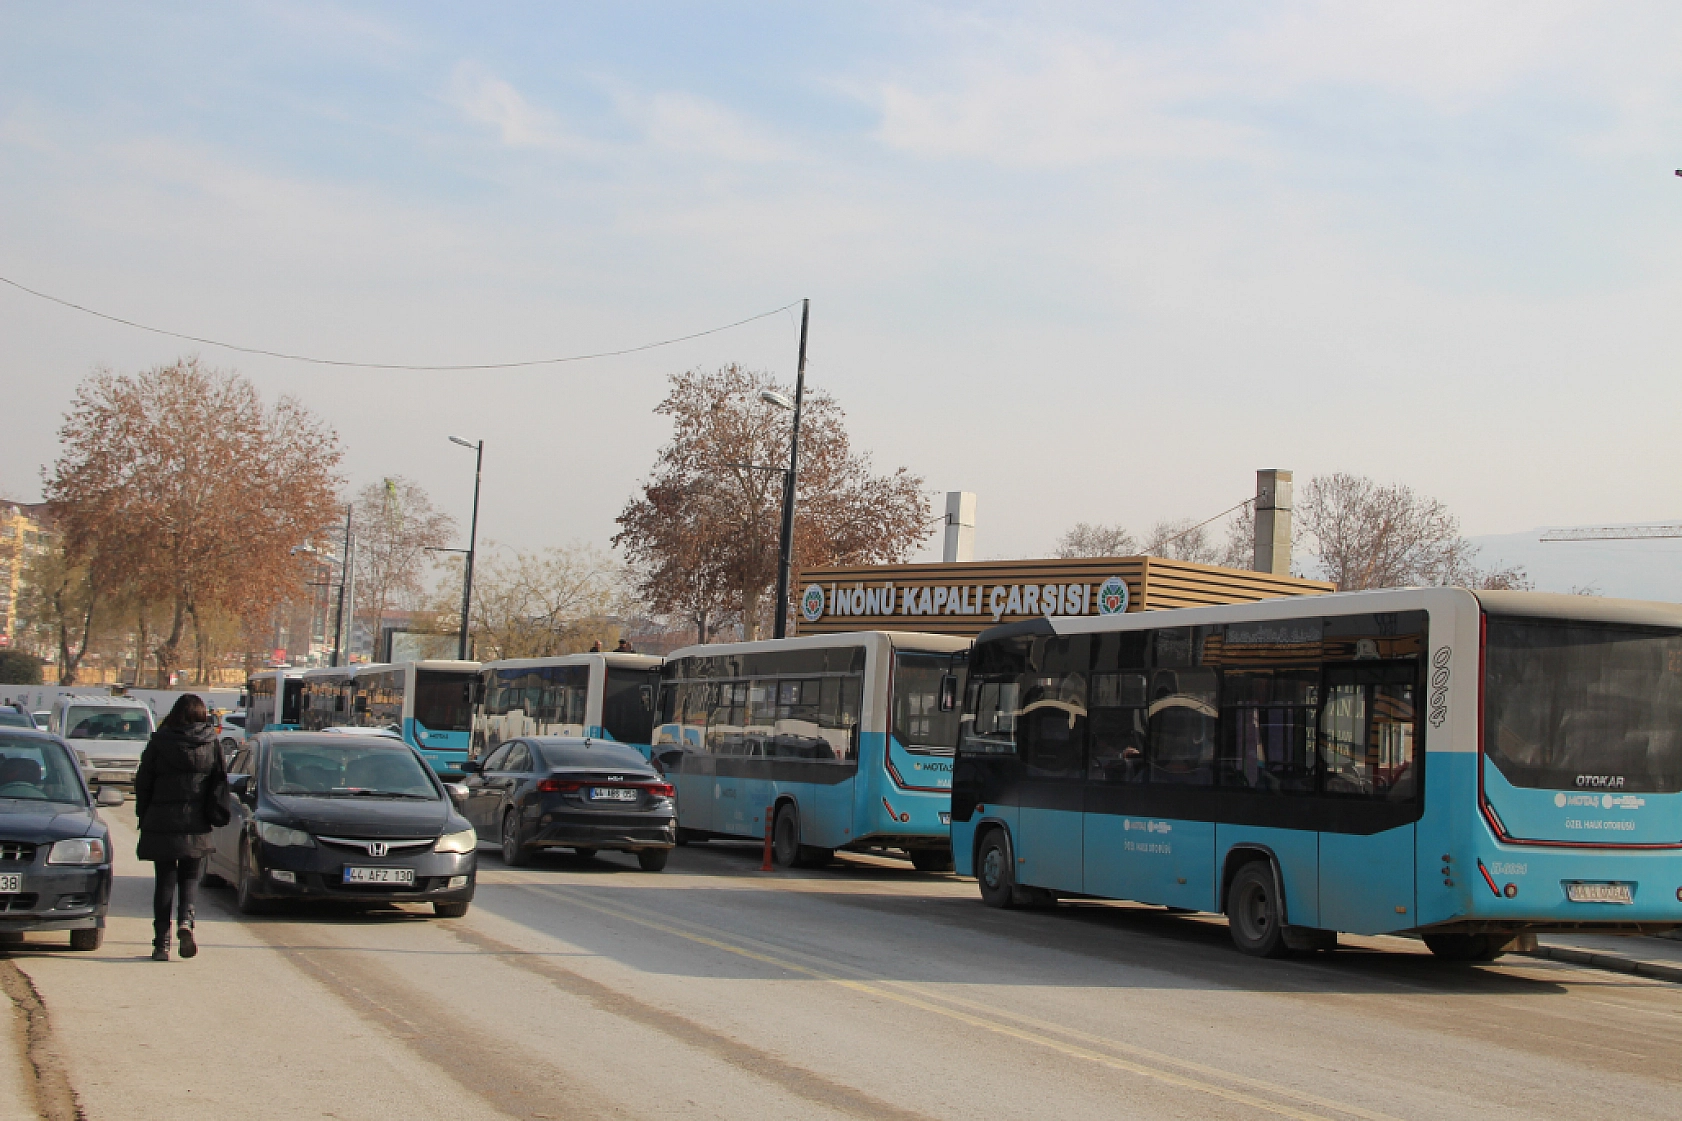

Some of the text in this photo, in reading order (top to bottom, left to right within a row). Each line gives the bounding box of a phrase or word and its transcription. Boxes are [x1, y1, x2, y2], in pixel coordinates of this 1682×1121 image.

[829, 582, 1091, 622] İNÖNÜ KAPALI ÇARŞISI
[1575, 775, 1625, 788] OTOKAR
[350, 869, 413, 882] 44 AFZ 130
[1, 875, 18, 891] 38
